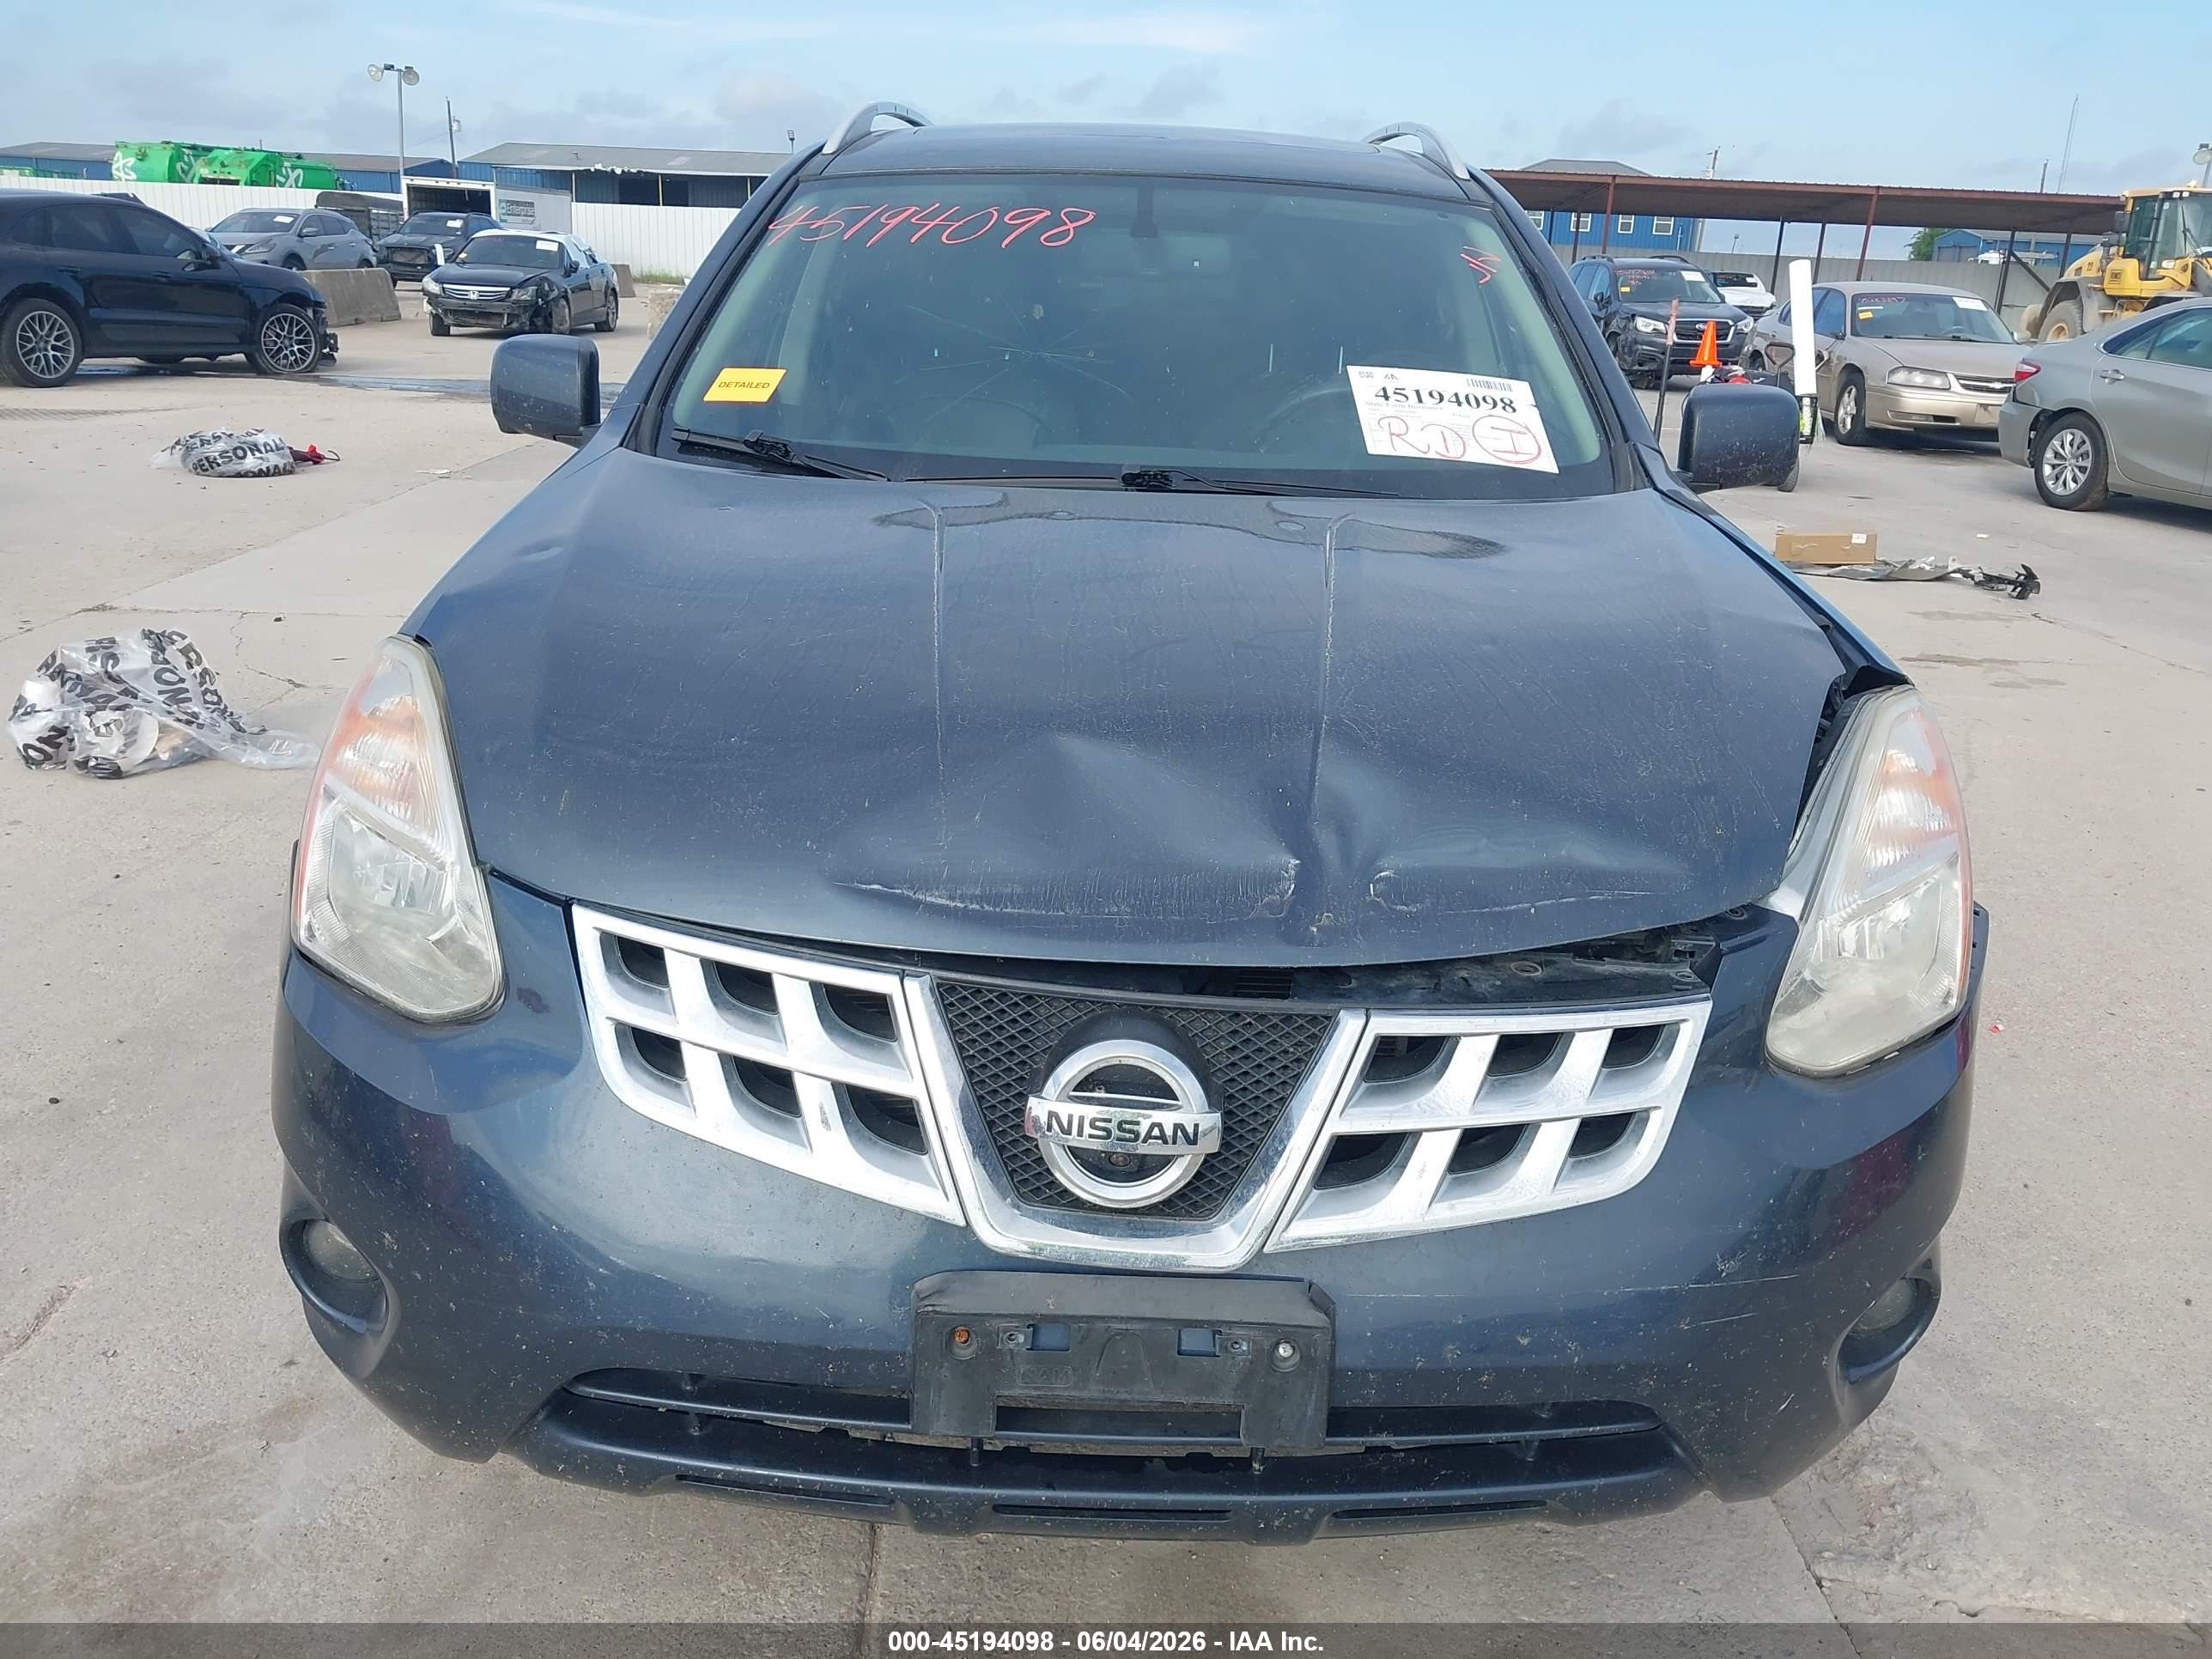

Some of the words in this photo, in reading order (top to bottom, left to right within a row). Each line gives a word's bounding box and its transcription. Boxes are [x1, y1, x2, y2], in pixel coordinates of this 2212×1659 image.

[768, 203, 1097, 249] 45194098
[1375, 386, 1517, 414] 45194098
[1046, 1109, 1200, 1146] NISSAN
